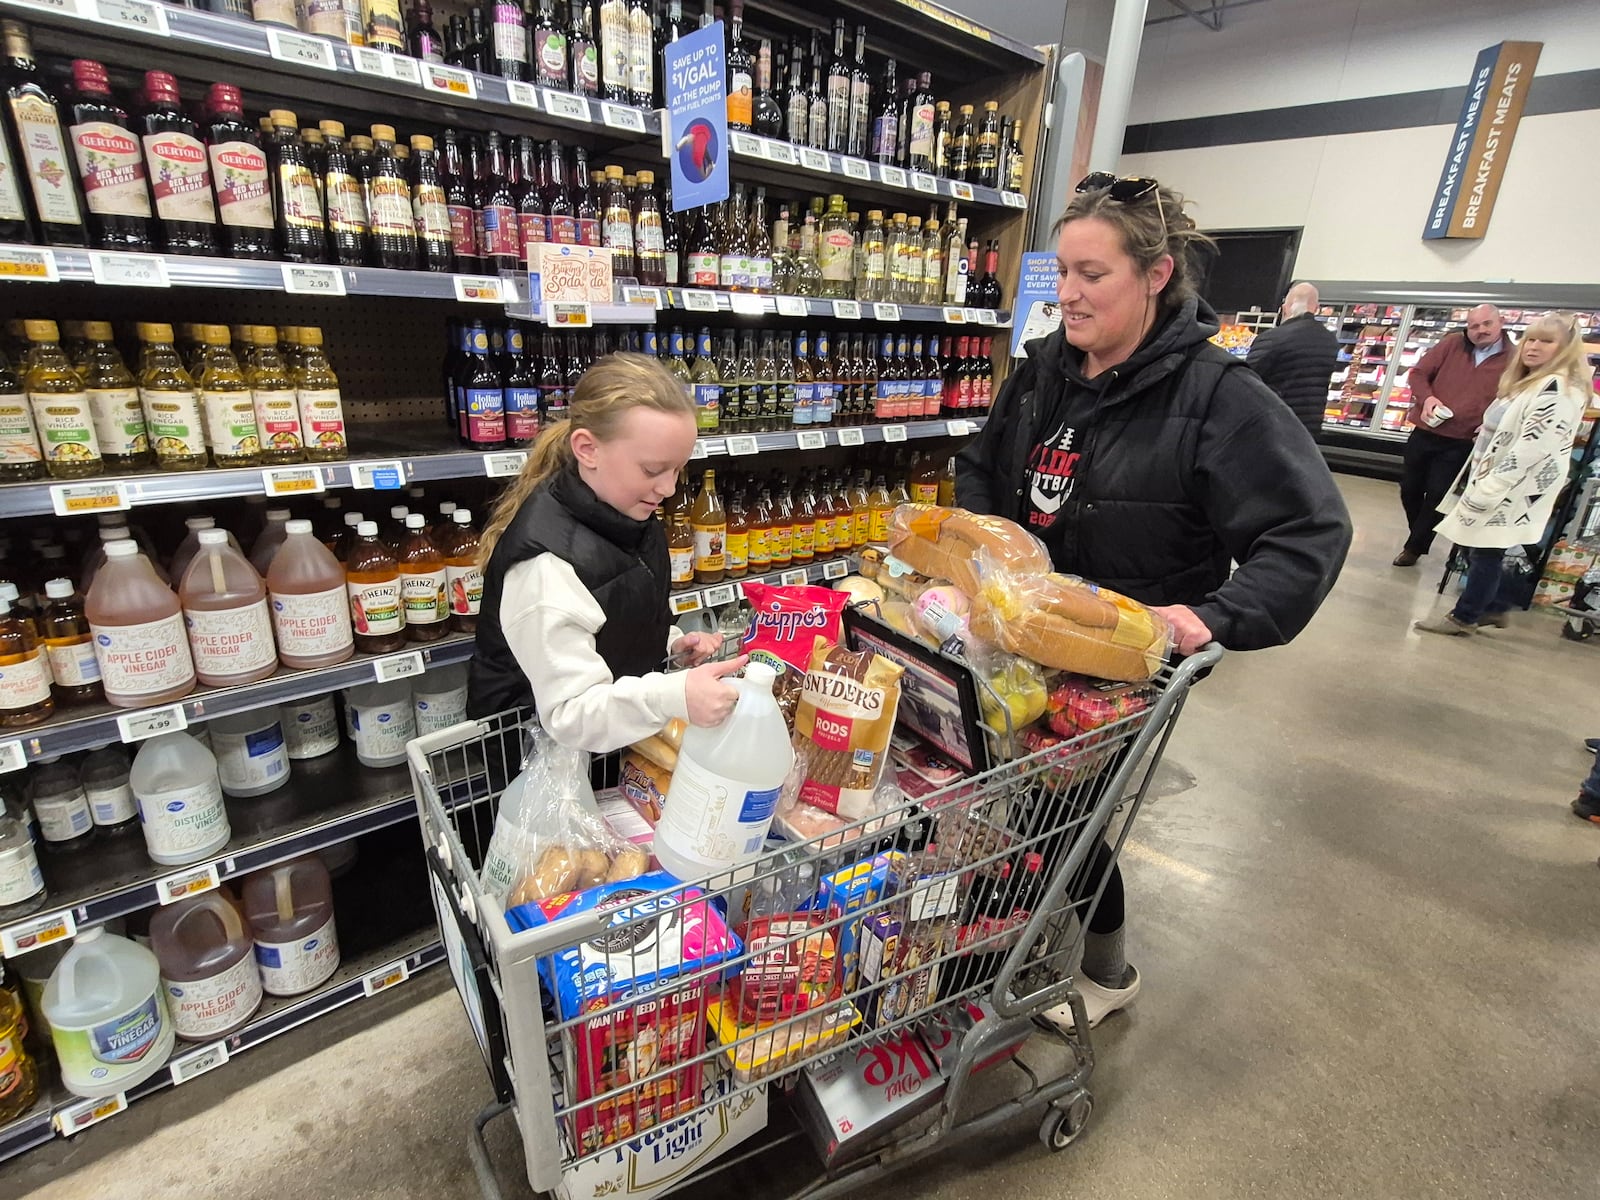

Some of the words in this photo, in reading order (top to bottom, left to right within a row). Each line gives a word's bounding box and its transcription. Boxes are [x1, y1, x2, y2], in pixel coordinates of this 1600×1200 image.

[121, 11, 148, 24] 5.49
[298, 49, 320, 61] 4.99
[672, 54, 692, 71] SAVE
[692, 49, 704, 62] UP
[705, 44, 717, 57] TO
[672, 95, 683, 107] AT
[683, 88, 698, 102] THE
[699, 80, 721, 97] PUMP
[672, 106, 687, 115] WITH
[687, 100, 700, 112] FUEL
[701, 92, 722, 106] POINTS
[82, 135, 135, 151] BERTOLLI
[1431, 131, 1470, 230] BREAKFAST
[1463, 66, 1490, 130] MEATS
[1462, 127, 1501, 229] BREAKFAST
[1493, 62, 1522, 125] MEATS
[156, 145, 203, 160] BERTOLLI
[221, 155, 265, 168] BERTOLLI
[96, 170, 112, 181] RED
[113, 165, 135, 177] WINE
[99, 174, 135, 187] VINEGAR
[168, 177, 184, 188] RED
[185, 173, 203, 184] WINE
[171, 181, 203, 194] VINEGAR
[232, 185, 247, 195] RED
[248, 181, 265, 192] WINE
[236, 189, 264, 202] VINEGAR
[551, 262, 585, 277] Baking
[1027, 258, 1048, 266] SHOP
[124, 270, 151, 280] 4.49
[309, 280, 330, 289] 2.99
[547, 275, 582, 294] Soda
[1027, 281, 1051, 289] EVERY
[294, 480, 311, 489] 2.99
[92, 496, 114, 506] 2.99
[405, 580, 431, 588] HEINZ
[367, 588, 394, 599] HEINZ
[405, 601, 437, 610] VINEGAR
[279, 617, 307, 629] APPLE
[309, 614, 338, 628] CIDER
[366, 610, 399, 621] VINEGAR
[220, 631, 254, 646] CIDER
[291, 626, 327, 638] VINEGAR
[107, 651, 143, 665] APPLE
[144, 644, 179, 661] CIDER
[202, 645, 241, 656] VINEGAR
[123, 660, 167, 674] VINEGAR
[396, 664, 412, 674] 4.29
[751, 653, 764, 663] FAT
[764, 655, 782, 673] FREE
[804, 673, 881, 711] SNYDER'S
[147, 719, 170, 730] 4.99
[816, 717, 849, 738] RODS
[174, 806, 216, 828] DISTILLED
[606, 897, 678, 929] REO
[745, 974, 761, 982] LACK
[180, 998, 215, 1012] APPLE
[217, 983, 248, 1004] CIDER
[196, 1000, 237, 1019] VINEGAR
[109, 1017, 156, 1050] VINEGAR
[195, 1057, 215, 1070] 6.99
[884, 1073, 922, 1103] Diet
[839, 1119, 854, 1134] 12
[653, 1122, 704, 1165] Light
